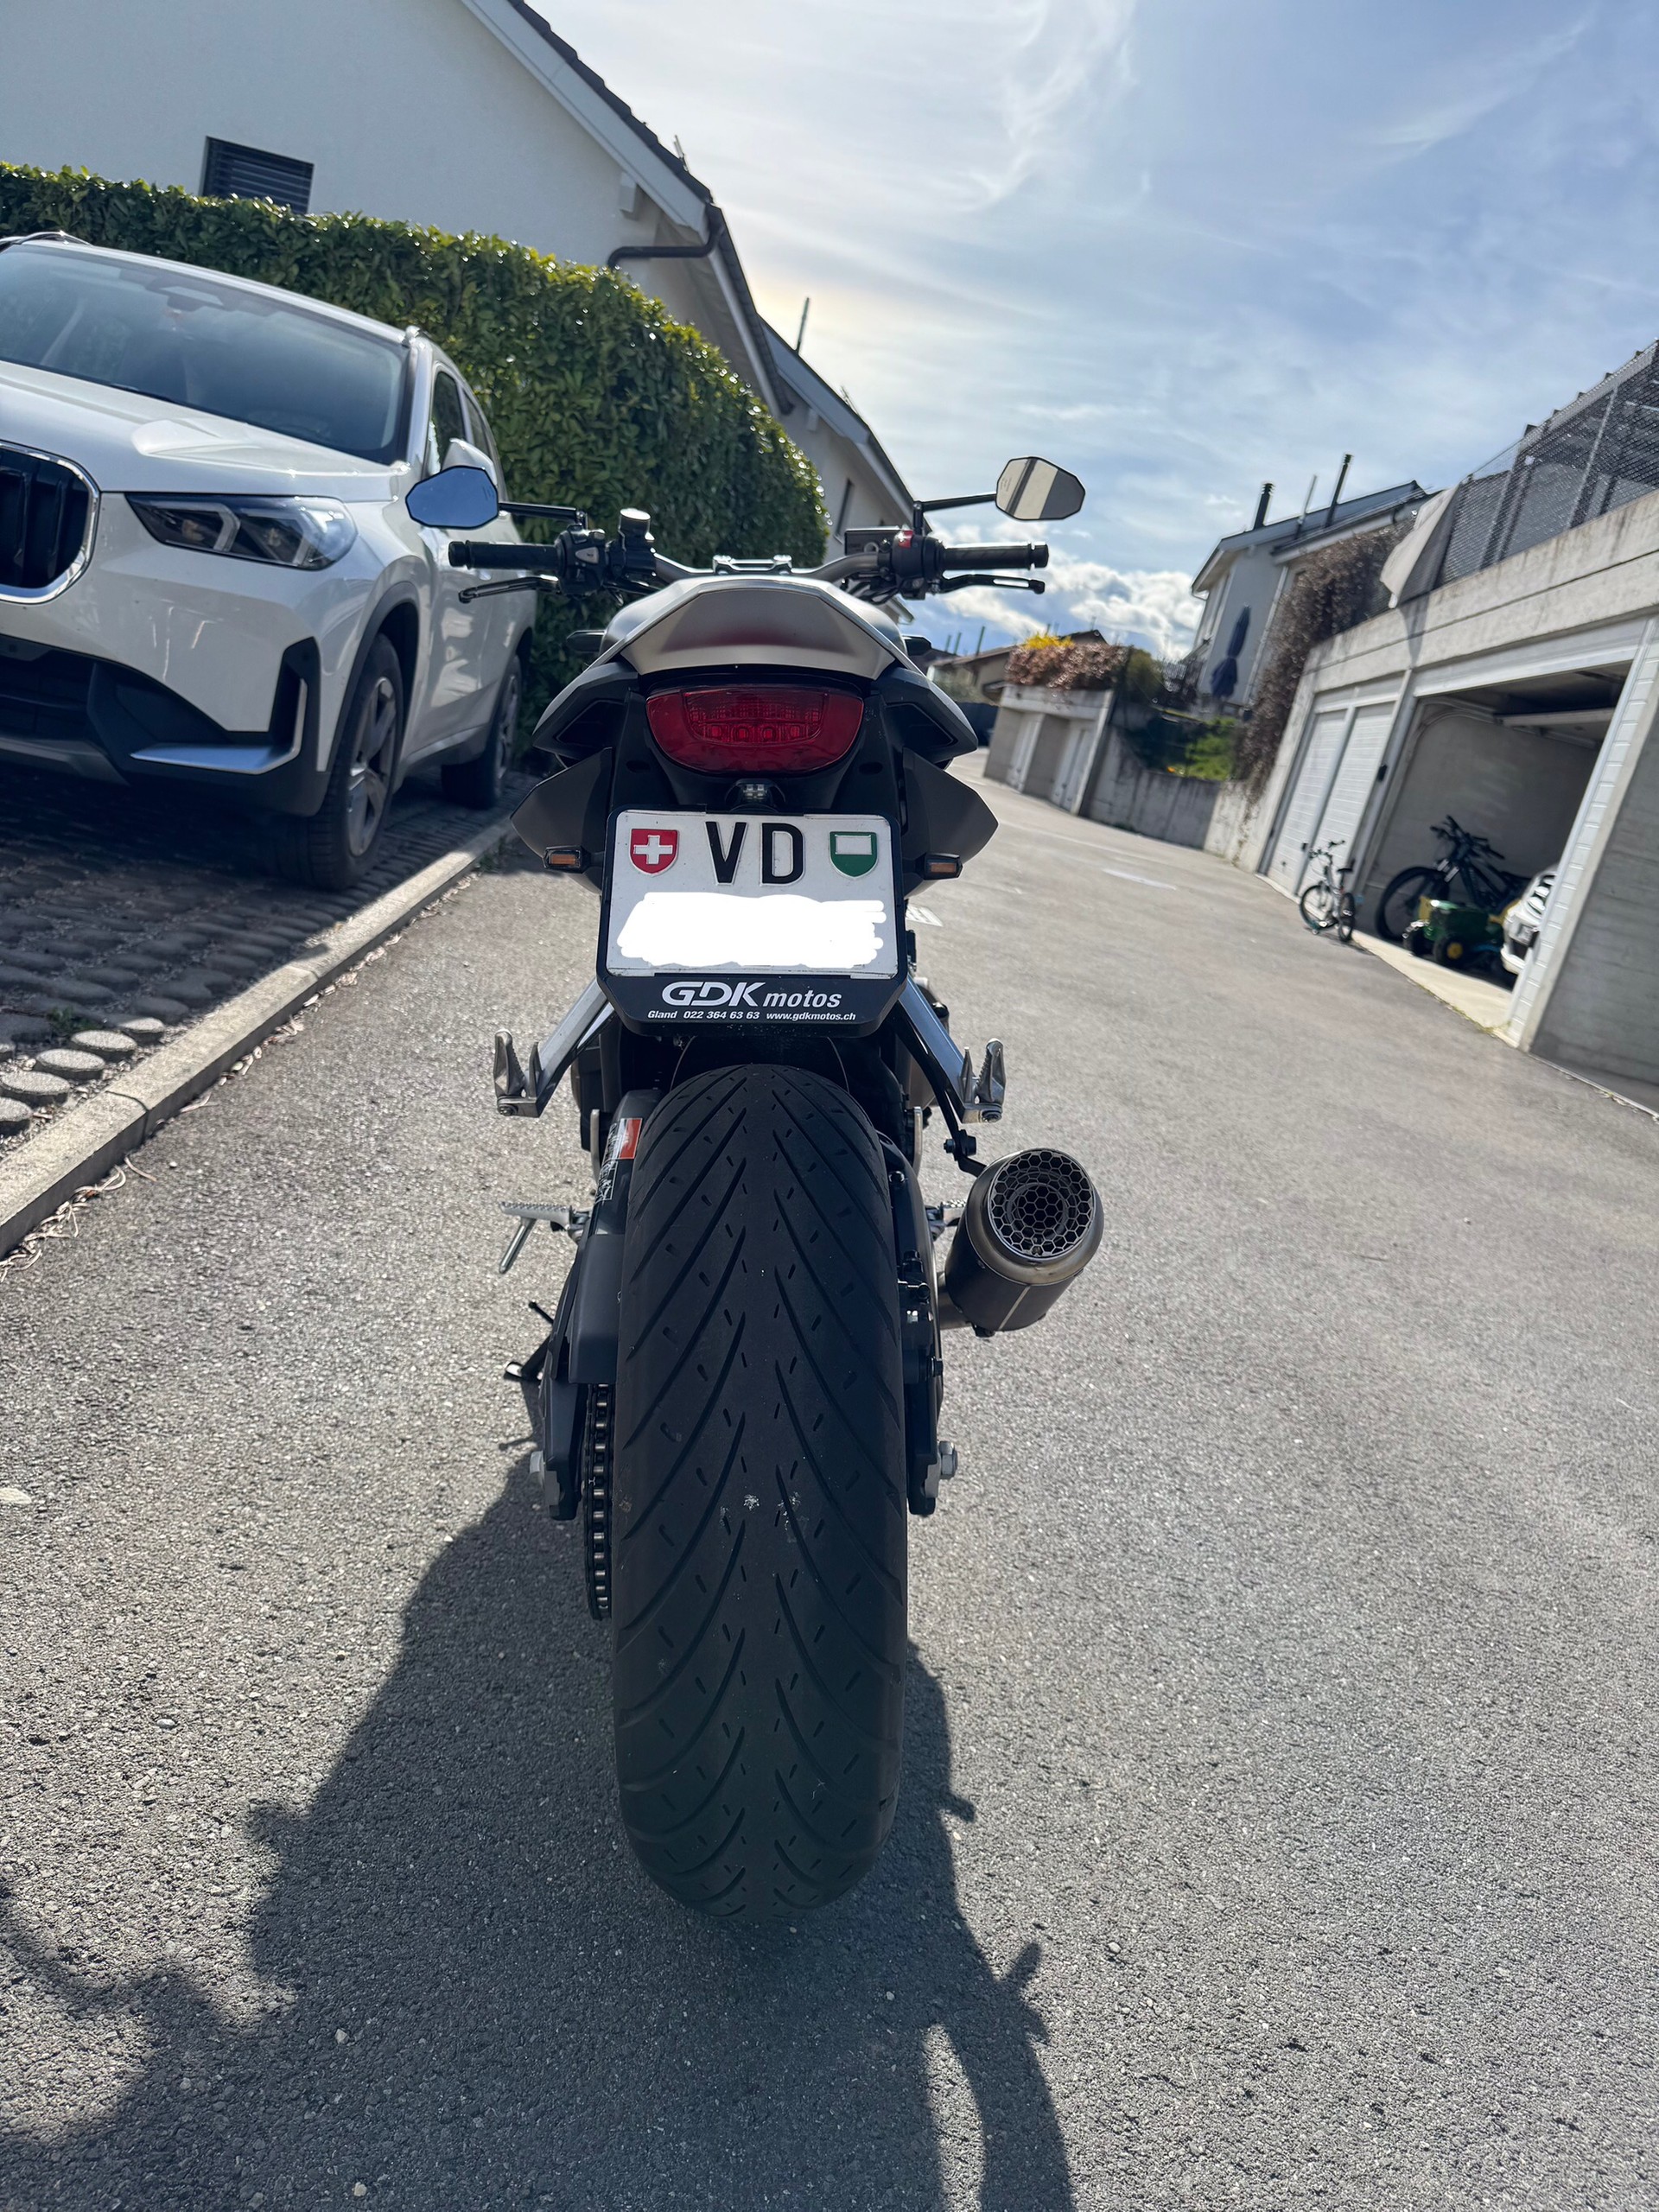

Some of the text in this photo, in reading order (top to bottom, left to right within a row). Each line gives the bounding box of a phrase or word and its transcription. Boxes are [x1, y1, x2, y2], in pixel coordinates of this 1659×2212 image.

[705, 821, 804, 885] VD
[661, 981, 842, 1008] GDK motos
[647, 1010, 856, 1021] Gland 022 364 63 63 www.gdkmotos.ch
